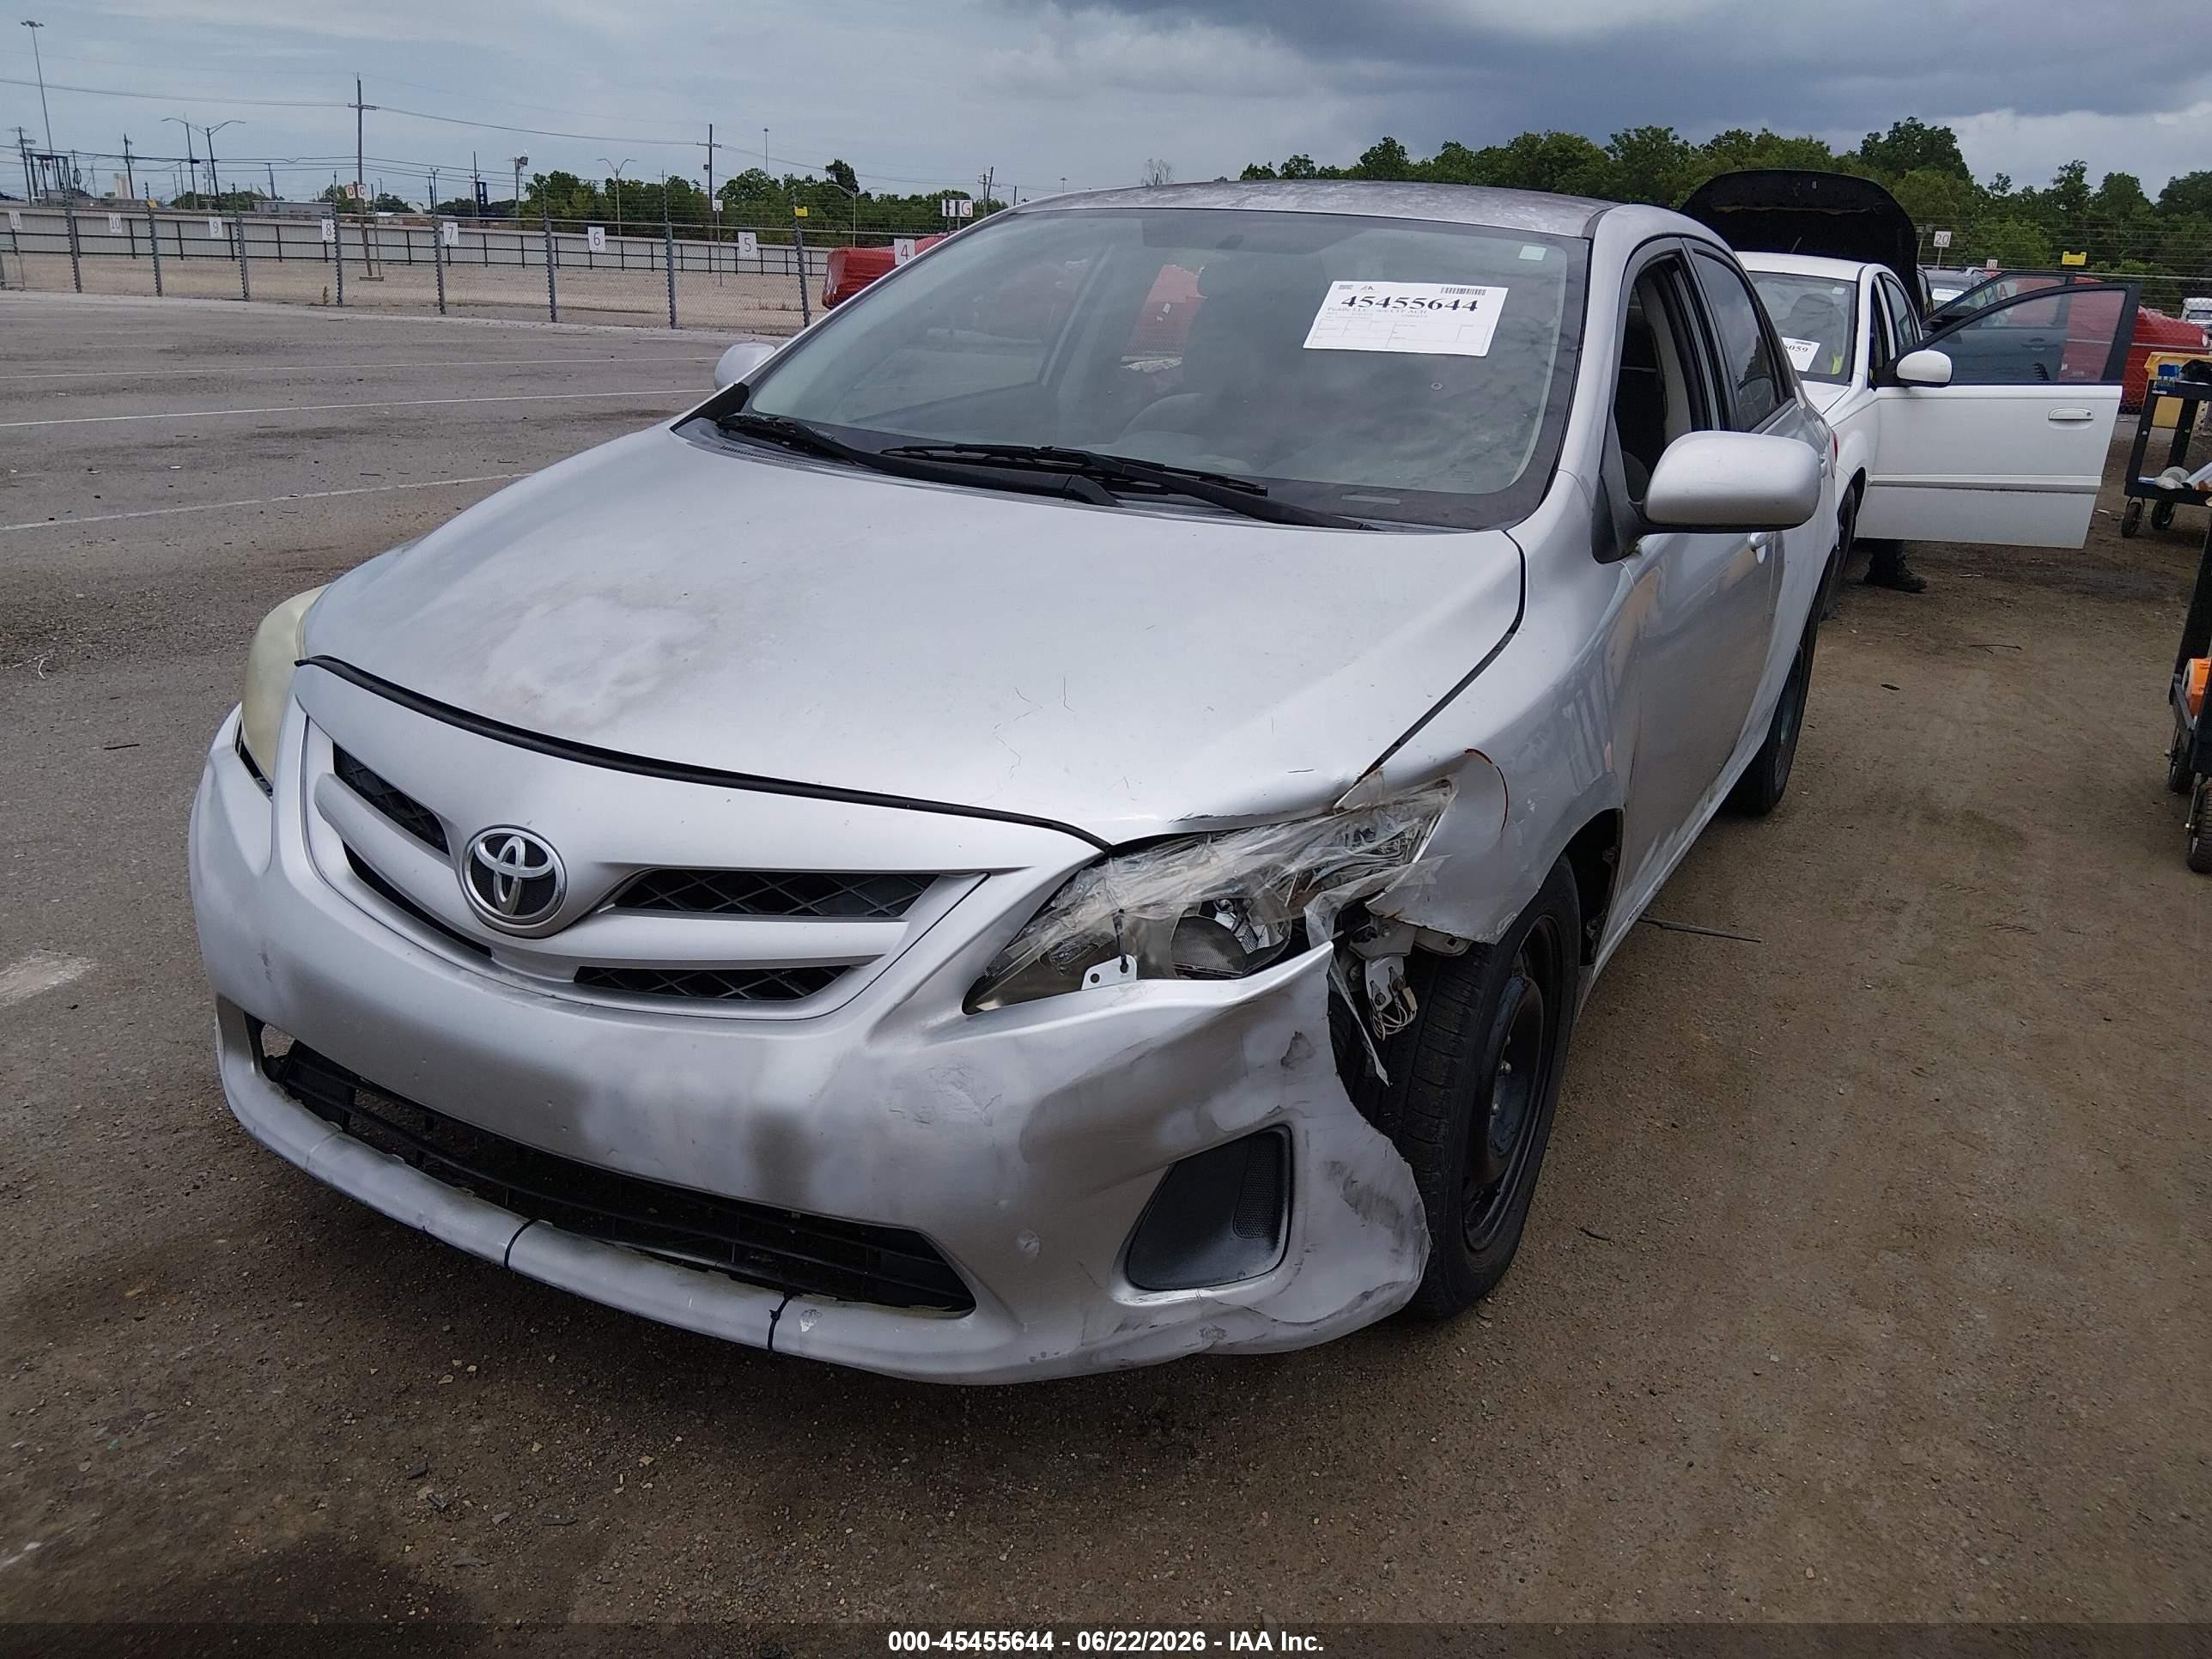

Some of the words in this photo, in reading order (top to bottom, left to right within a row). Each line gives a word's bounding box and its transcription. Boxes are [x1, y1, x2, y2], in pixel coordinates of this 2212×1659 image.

[348, 186, 354, 196] D
[360, 186, 365, 196] C
[962, 201, 971, 216] G
[111, 216, 120, 229] 10
[212, 221, 219, 234] 9
[325, 223, 331, 236] 8
[447, 227, 454, 240] 7
[592, 232, 601, 246] 6
[744, 237, 751, 252] 5
[1935, 234, 1950, 246] 20
[900, 244, 909, 261] 4
[1340, 295, 1479, 312] 45455644
